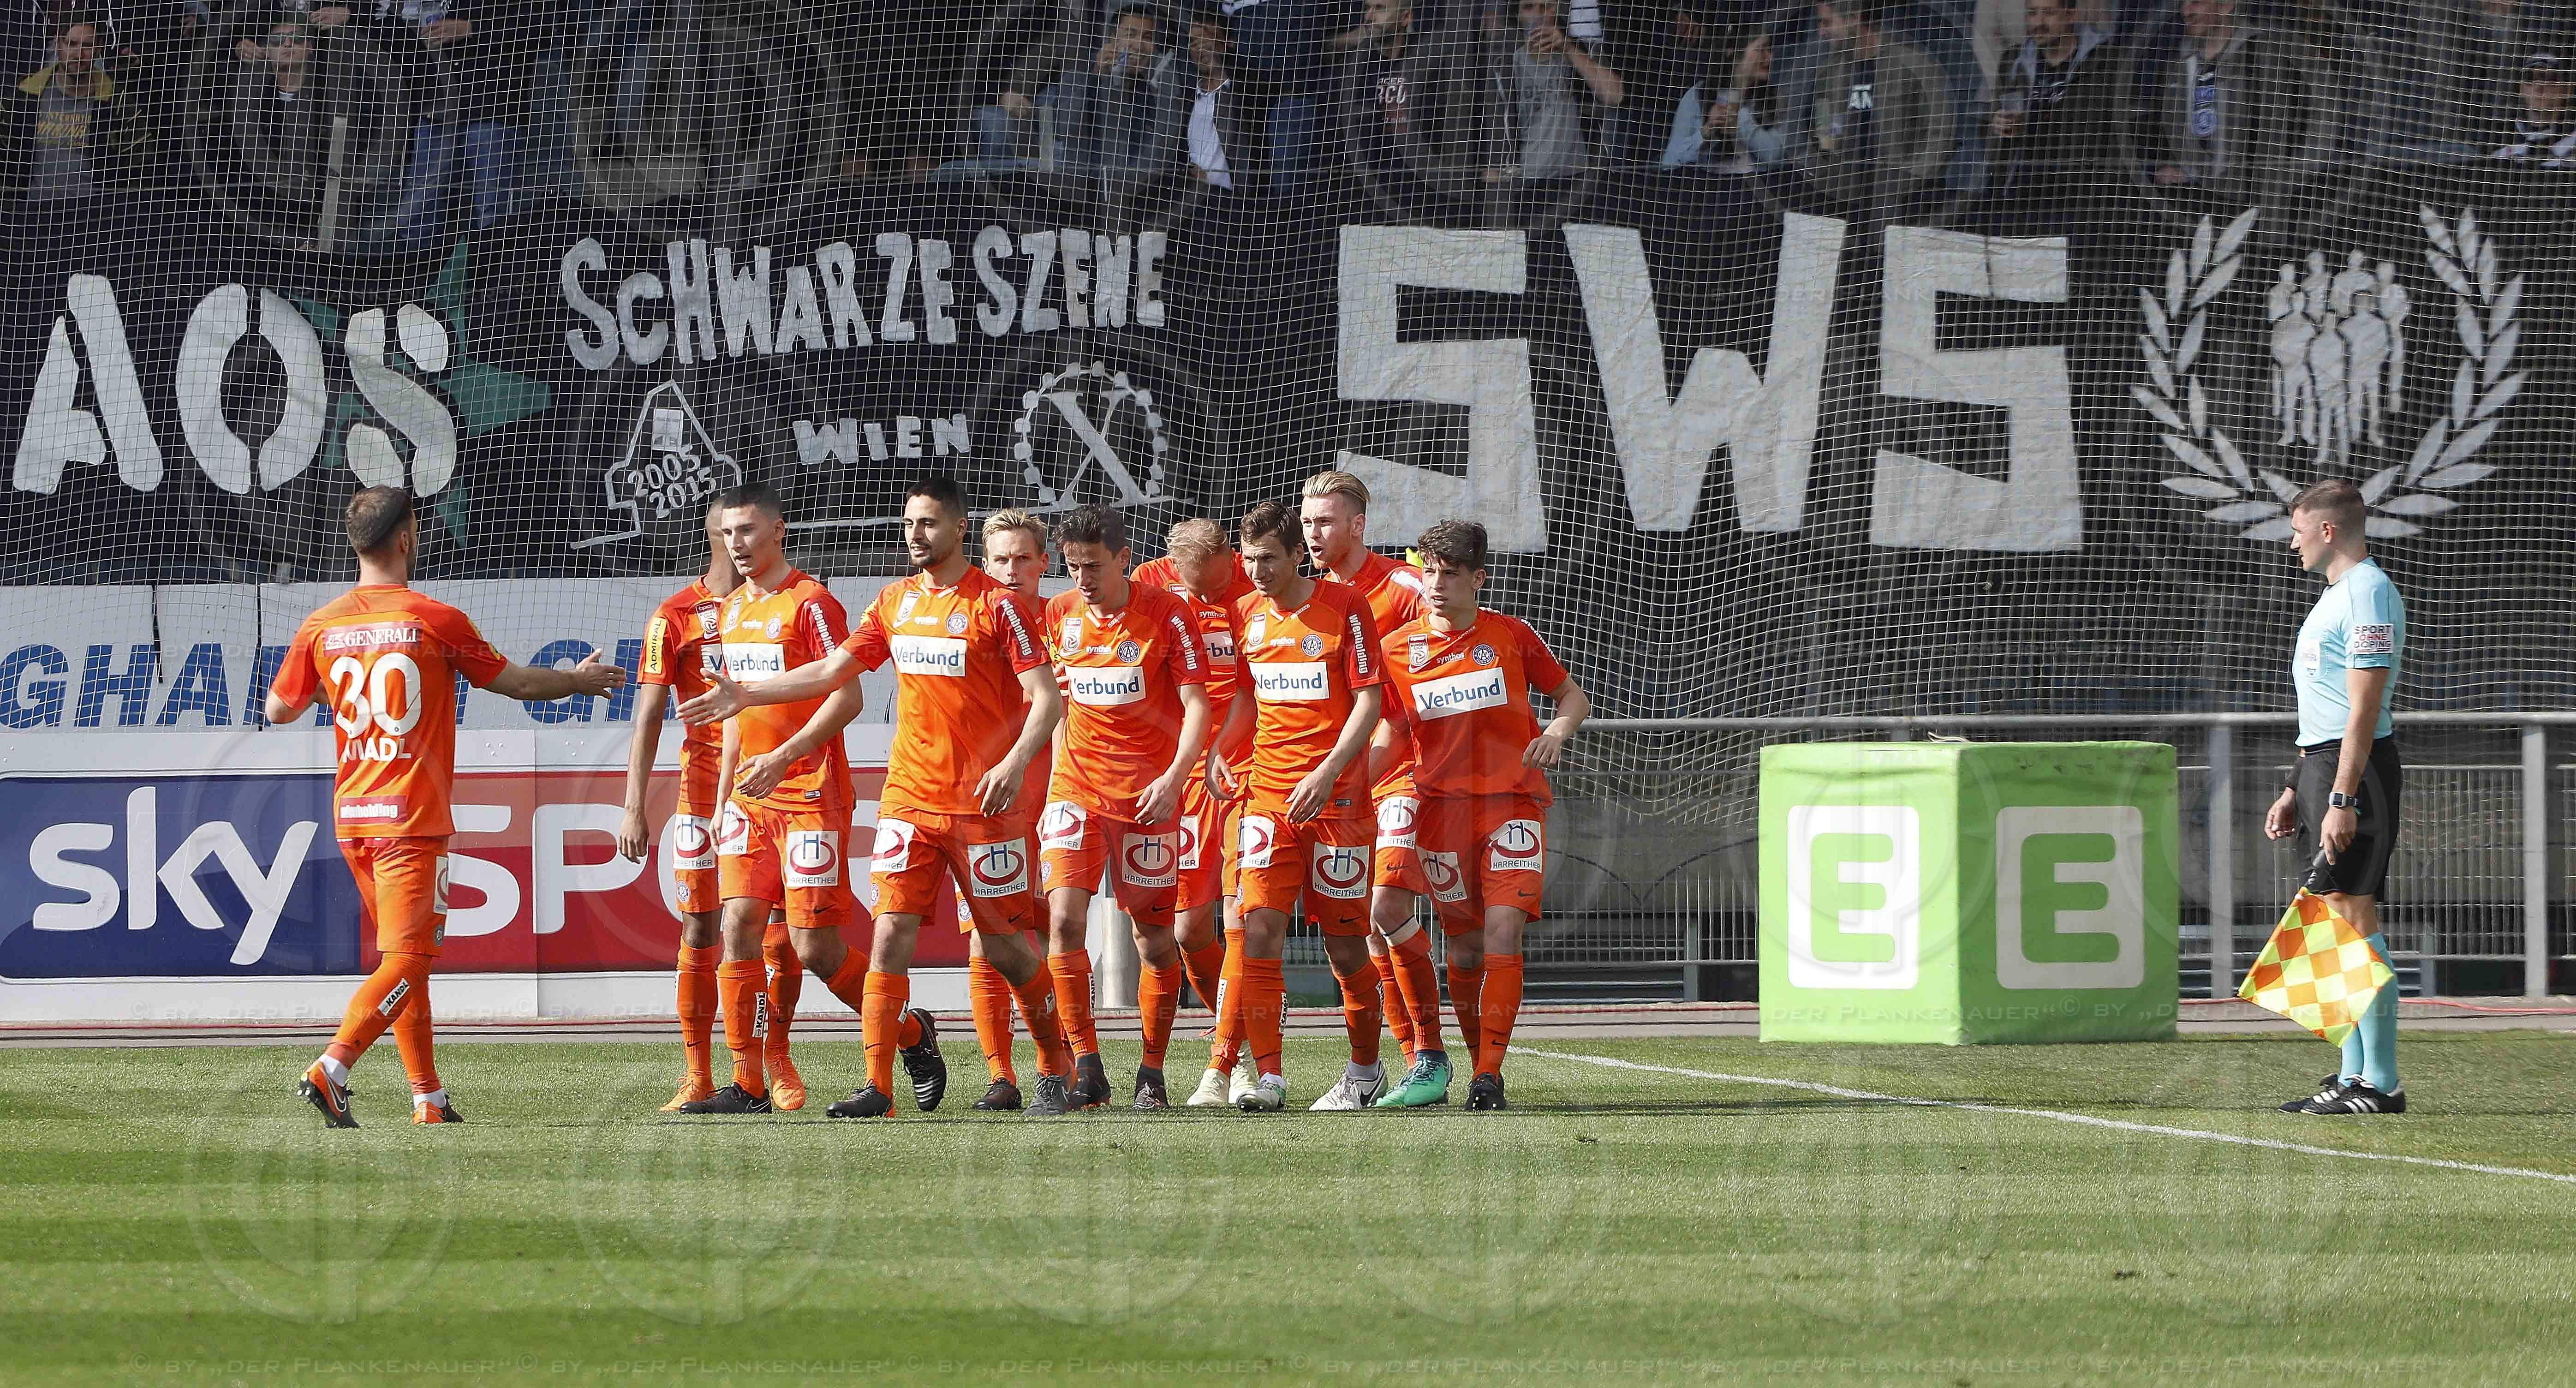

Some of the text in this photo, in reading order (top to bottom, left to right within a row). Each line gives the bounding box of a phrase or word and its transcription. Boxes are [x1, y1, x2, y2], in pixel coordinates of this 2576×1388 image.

[972, 225, 1167, 337] SZENE
[13, 273, 457, 498] AOS
[1336, 212, 2081, 552] SWS
[792, 413, 971, 465] WIEN
[628, 443, 701, 497] 2005
[650, 467, 716, 519] 2015
[346, 627, 417, 647] GENERALI
[650, 622, 663, 671] ADMIRAL
[2354, 625, 2391, 634] SPORT
[726, 654, 779, 671] Verbund
[895, 646, 960, 667] Verbund
[329, 652, 421, 739] 30
[1073, 676, 1139, 695] erbund
[1254, 672, 1323, 690] Verbund
[1419, 677, 1501, 710] Verbund
[30, 785, 319, 966] sky
[1124, 874, 1175, 885] HARREITHER
[1493, 860, 1541, 868] HARREITHER
[975, 882, 1026, 896] HARREITHER
[1315, 882, 1364, 897] HARREITHER
[1811, 833, 1895, 963] E
[2021, 832, 2120, 963] E
